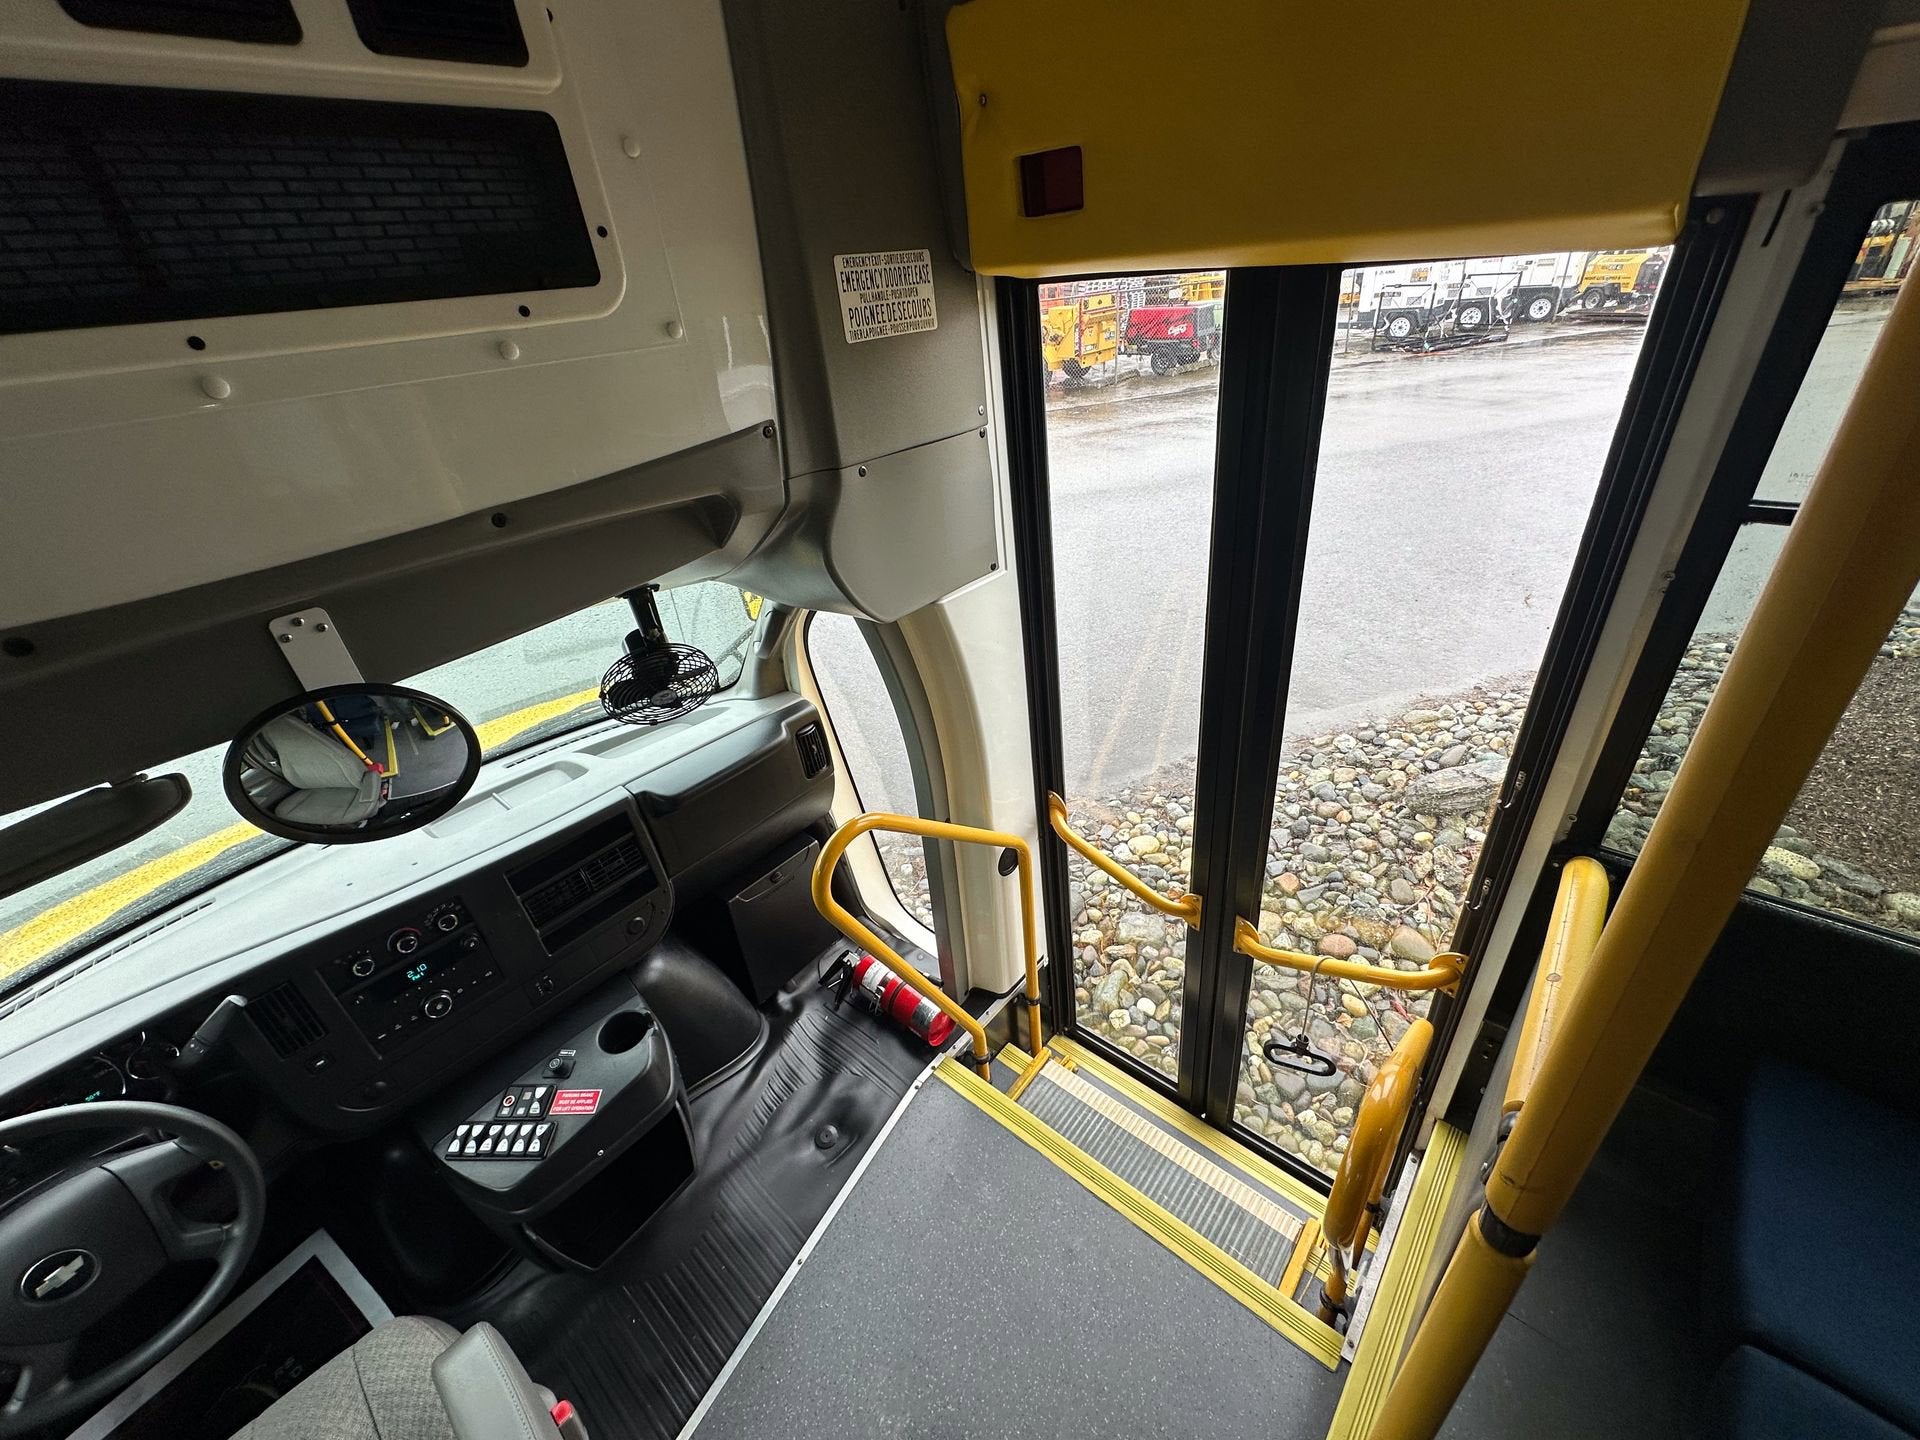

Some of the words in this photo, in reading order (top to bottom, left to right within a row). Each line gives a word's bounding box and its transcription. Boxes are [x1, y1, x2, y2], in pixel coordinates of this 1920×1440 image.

[842, 255, 872, 268] EMERGENCY
[840, 268, 884, 292] EMERGENCY
[884, 266, 904, 288] DOOR
[903, 264, 930, 286] RELEASE
[871, 290, 889, 302] HANDLE
[848, 304, 886, 328] POIGNEE
[886, 302, 897, 322] DE
[897, 298, 932, 320] SECOURS
